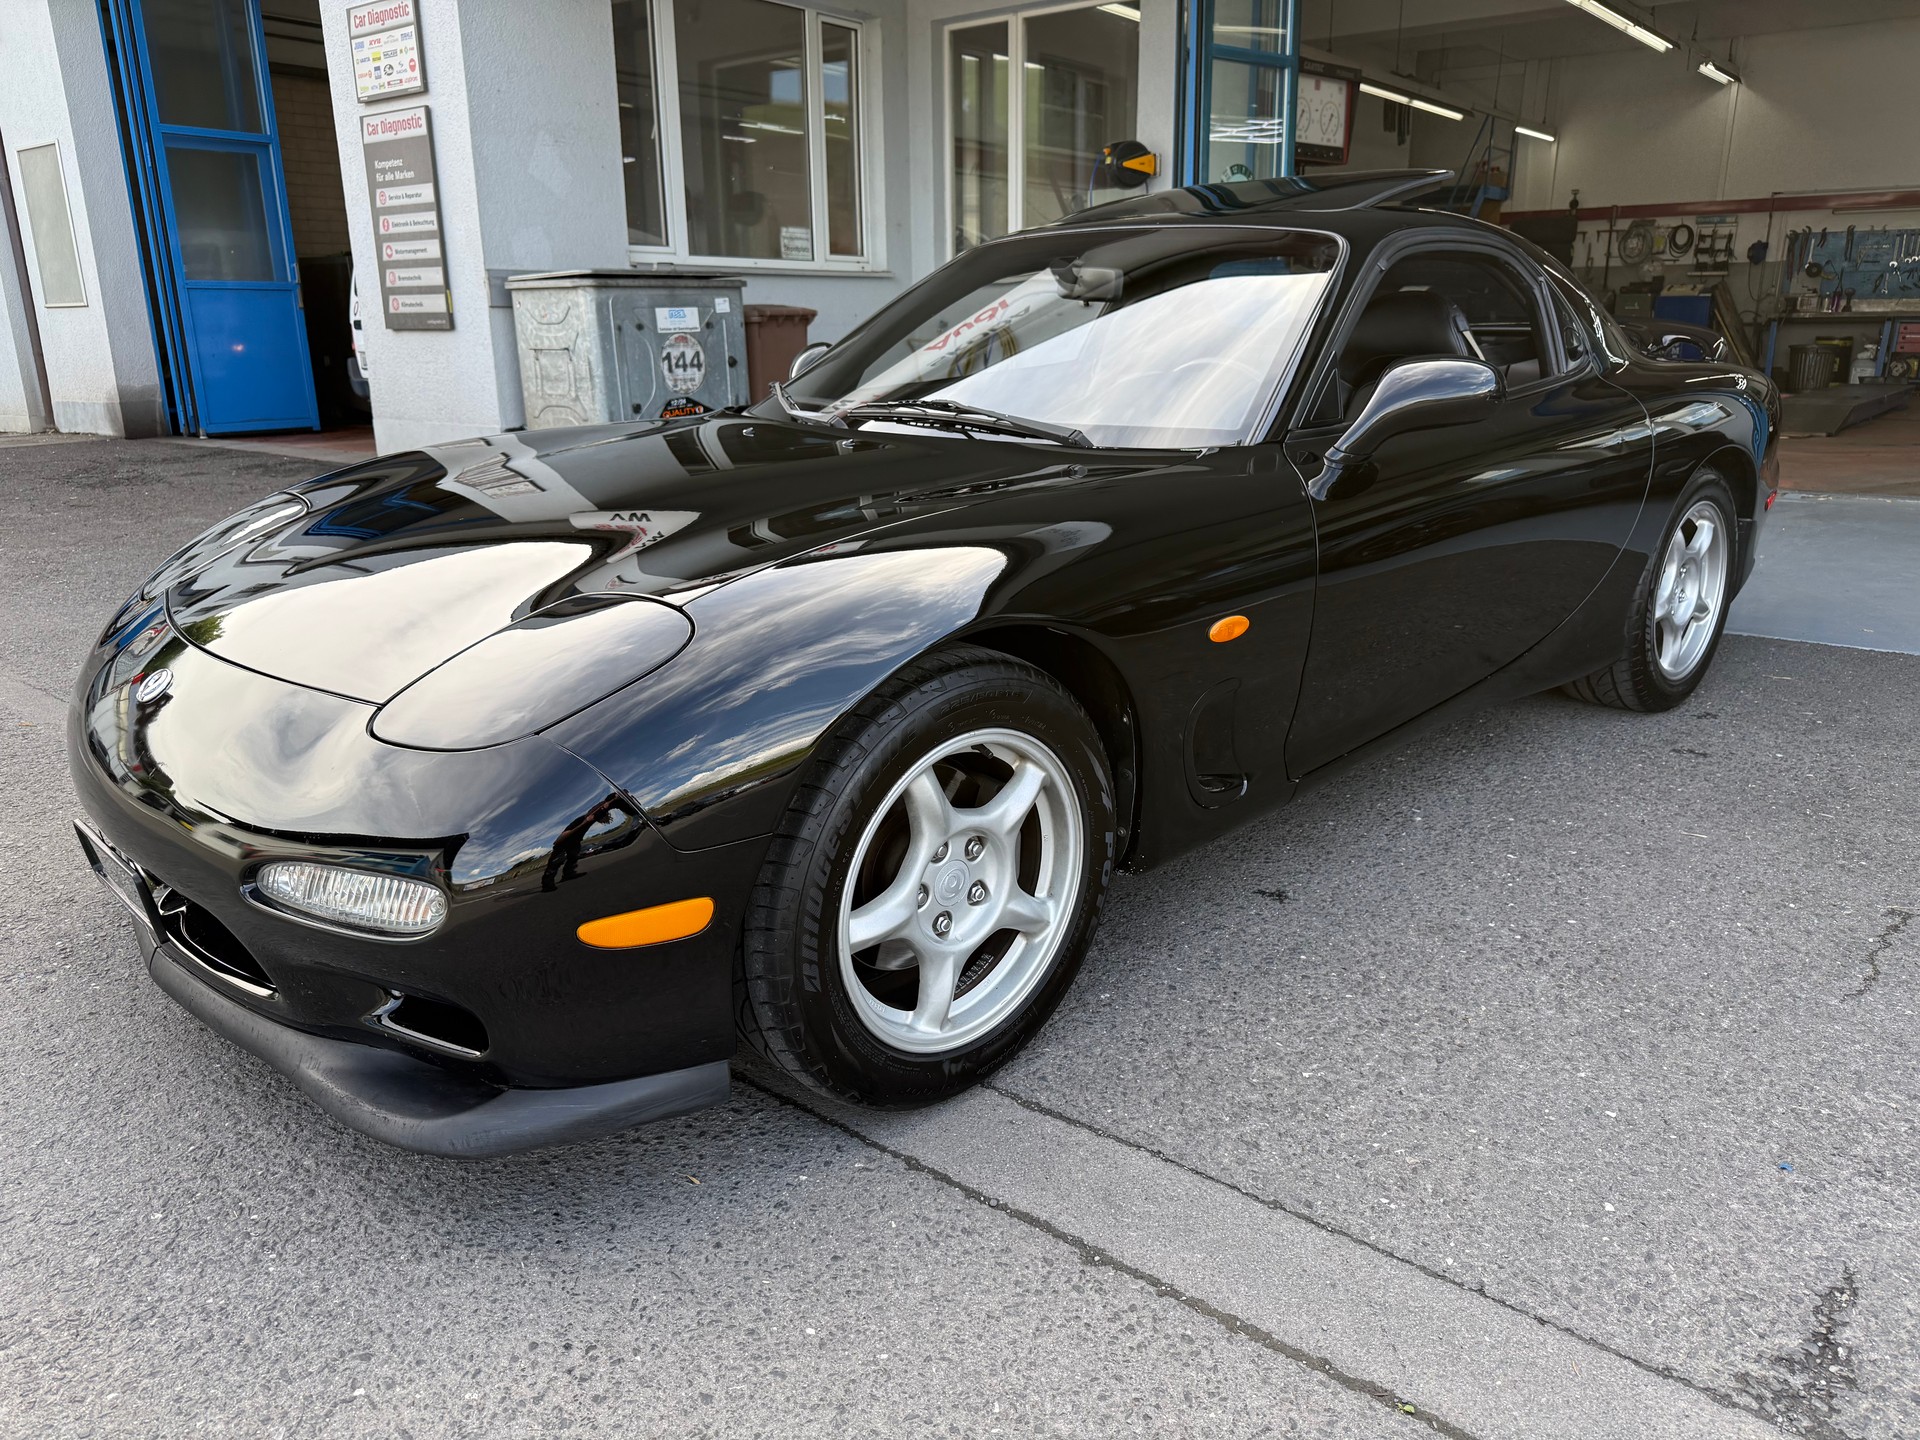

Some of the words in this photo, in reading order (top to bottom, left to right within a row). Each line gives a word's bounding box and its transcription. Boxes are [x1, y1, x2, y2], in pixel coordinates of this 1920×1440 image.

[353, 14, 367, 29] Car
[367, 1, 410, 26] Diagnostic
[366, 122, 379, 137] Car
[380, 113, 423, 136] Diagnostic
[375, 158, 403, 170] Kompetenz
[376, 171, 384, 182] für
[384, 171, 394, 181] alle
[394, 169, 415, 181] Marken
[388, 193, 401, 202] Service
[405, 191, 422, 200] Reparatur
[391, 219, 409, 229] Elektronik
[412, 218, 435, 228] Beleuchtung
[395, 246, 428, 256] Motormanagement
[661, 351, 703, 374] 144
[802, 720, 920, 992] BRIDGESTONE
